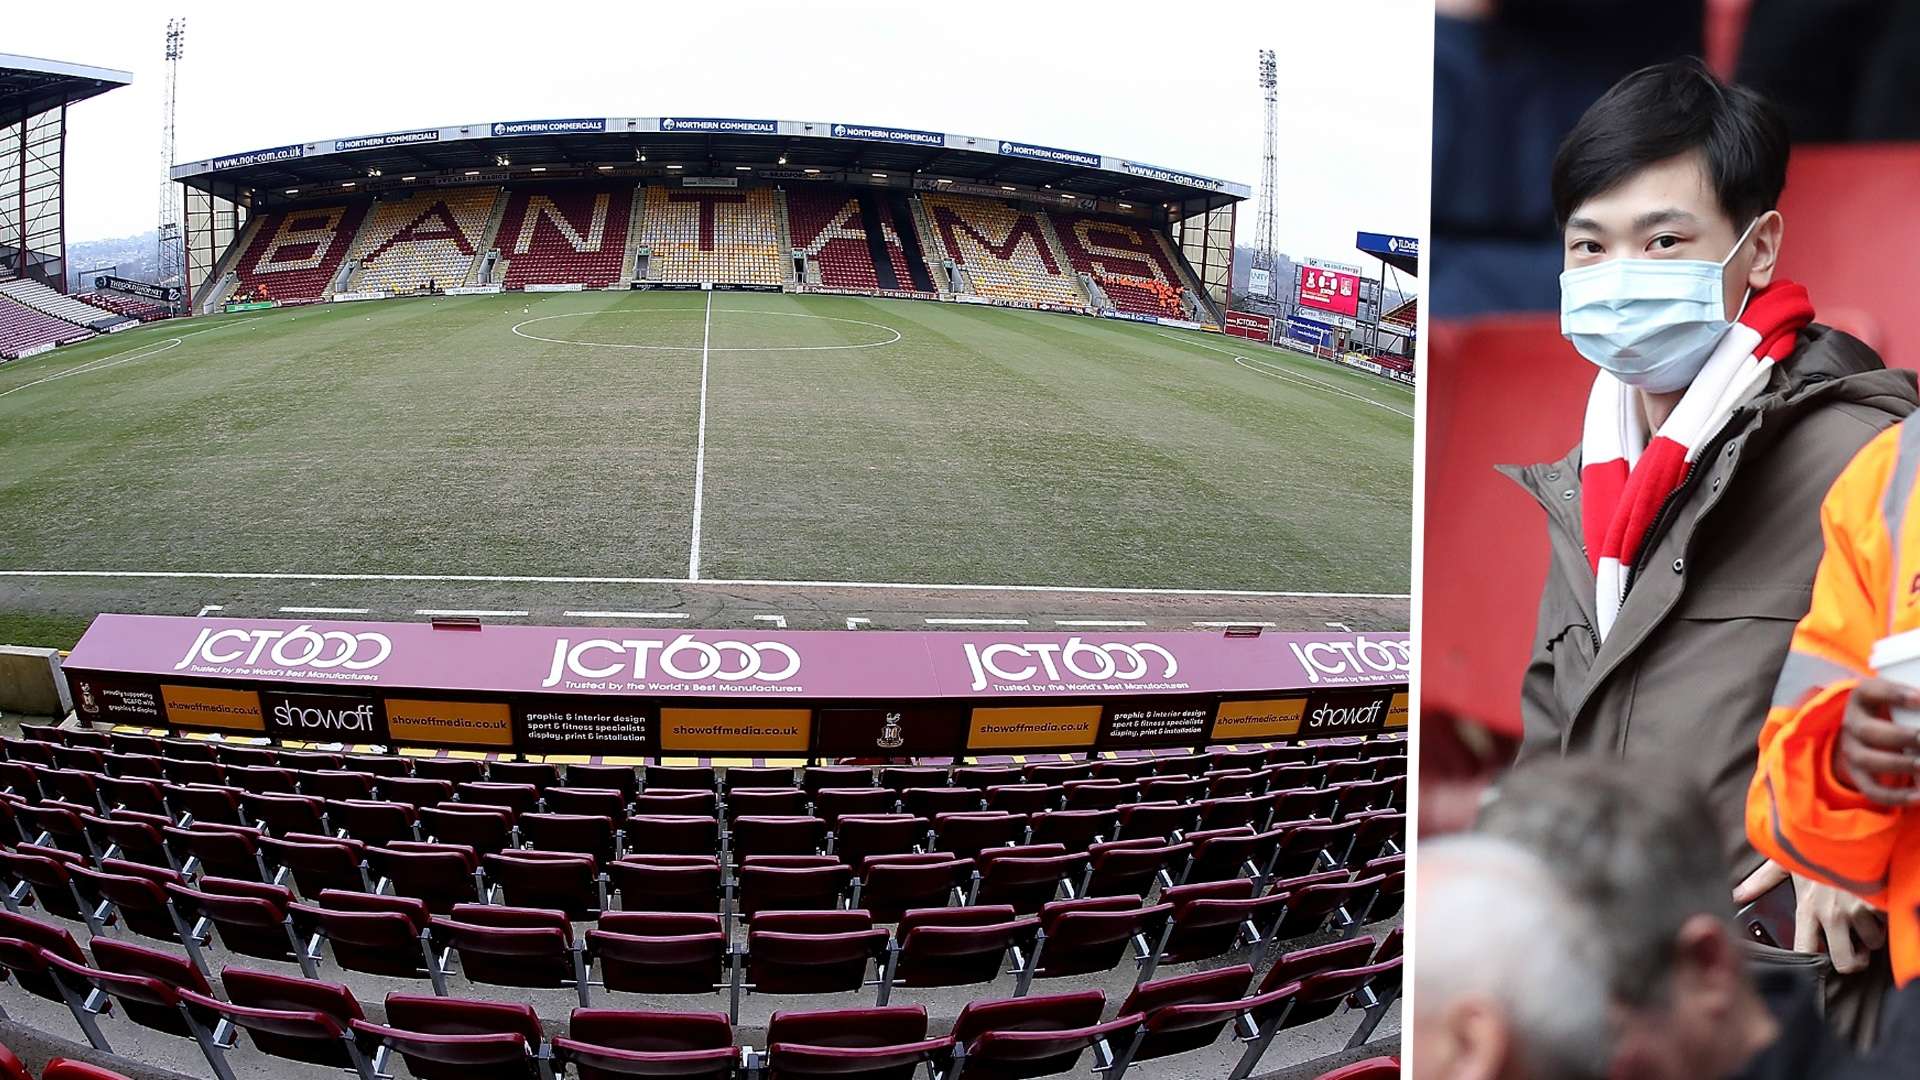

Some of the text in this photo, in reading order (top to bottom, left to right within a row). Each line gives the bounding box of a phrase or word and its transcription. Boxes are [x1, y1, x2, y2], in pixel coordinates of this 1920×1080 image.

[506, 121, 602, 133] NORTHERN COMMERCIALS
[675, 120, 774, 131] NORTHERN COMMERCIALS
[344, 132, 437, 149] NORTHERN COMMERCIALS
[847, 128, 942, 144] NORTHERN COMMERCIALS
[215, 143, 301, 169] www.nor-com.co.uk
[1013, 145, 1098, 166] NORTHERN COMMERCIALS
[1129, 166, 1218, 191] www.nor-com.co.uk
[174, 625, 392, 670] JCT600
[542, 634, 801, 687] JCT600
[963, 636, 1179, 691] JCT600
[190, 665, 220, 673] Trusted
[221, 666, 234, 675] by
[252, 668, 284, 677] World's
[286, 669, 305, 677] Best
[307, 671, 378, 681] Manufacturers
[565, 680, 803, 692] Trusted by the World's Best Manufacturers
[993, 684, 1031, 692] Trusted
[1032, 684, 1046, 692] by
[1049, 683, 1064, 691] the
[1065, 683, 1101, 691] World's
[168, 702, 259, 716] showoffmedia.co.uk
[274, 699, 373, 731] showoff
[1114, 711, 1145, 720] graphic
[1153, 710, 1181, 718] interior
[1182, 709, 1206, 718] design
[1309, 700, 1383, 728] showoff
[392, 716, 507, 730] showoffmedia.co.uk
[527, 713, 563, 721] graphic
[574, 713, 611, 722] interior
[613, 714, 646, 724] design
[1112, 721, 1133, 729] sport
[1140, 719, 1165, 727] fitness
[1166, 718, 1204, 727] specialists
[1218, 714, 1300, 726] showoffmedia.co.uk
[527, 722, 552, 730] sport
[562, 722, 593, 731] fitness
[595, 724, 646, 732] specialists
[673, 724, 798, 736] showoffmedia.co.uk
[980, 721, 1089, 734] showoffmedia.co.uk
[1110, 729, 1139, 737] display,
[1140, 728, 1157, 737] print
[1164, 727, 1201, 735] installation
[528, 731, 646, 741] display, print & installation
